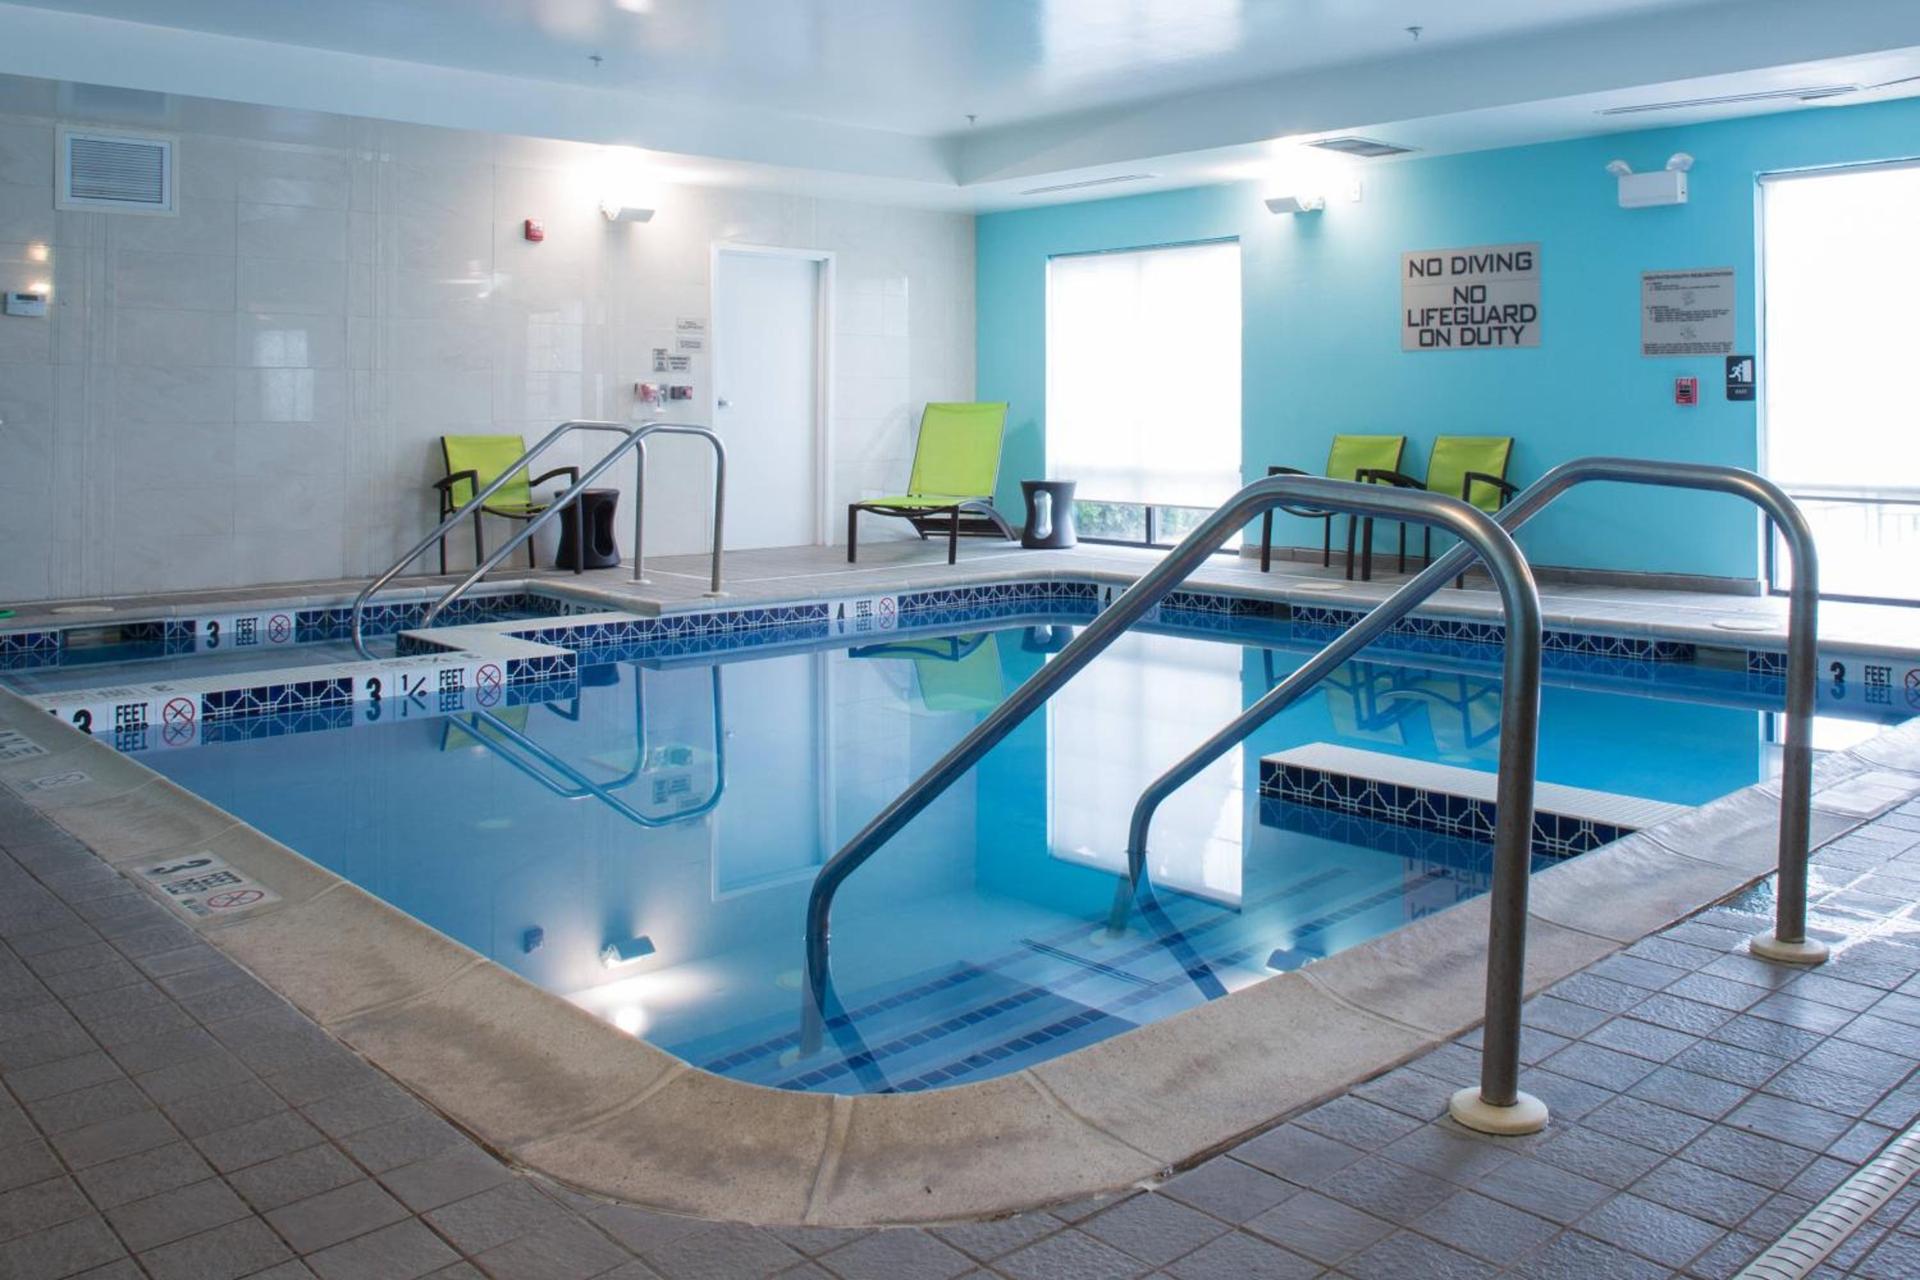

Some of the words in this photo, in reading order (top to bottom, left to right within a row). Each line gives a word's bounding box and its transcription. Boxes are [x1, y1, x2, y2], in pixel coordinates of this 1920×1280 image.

[1409, 258, 1442, 278] NO
[1451, 251, 1532, 275] DIVING
[1453, 285, 1486, 304] NO
[1407, 304, 1537, 327] LIFEGUARD
[1419, 328, 1451, 347] ON
[1460, 325, 1525, 346] DUTY
[1830, 661, 1846, 681] 3
[1864, 665, 1893, 683] FEET
[366, 677, 381, 701] 3
[440, 668, 465, 686] FEET
[116, 703, 148, 724] FEET
